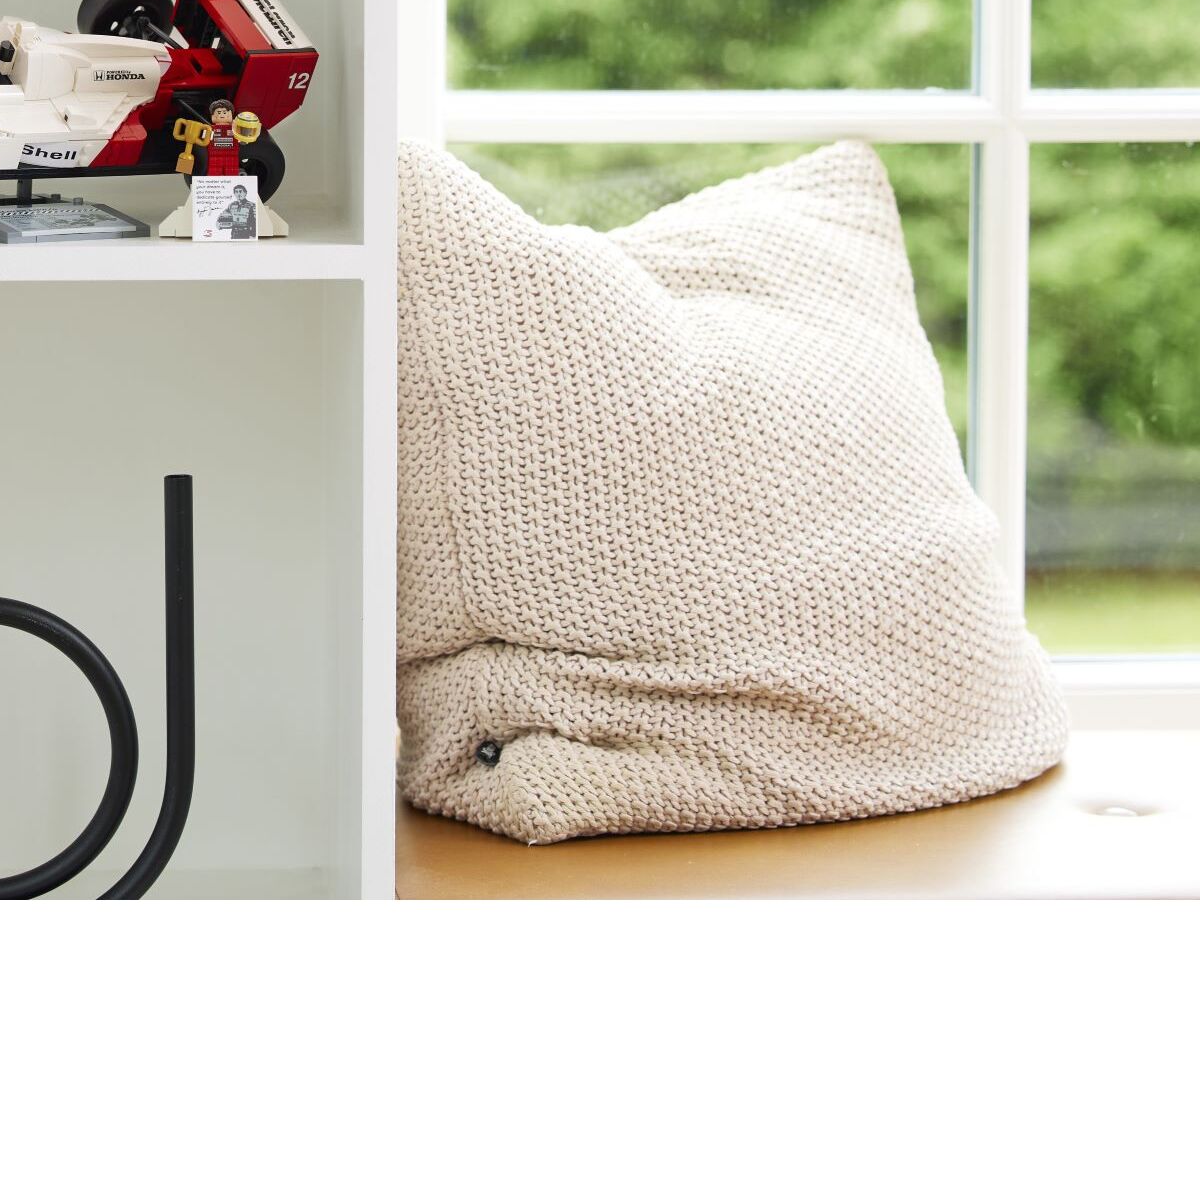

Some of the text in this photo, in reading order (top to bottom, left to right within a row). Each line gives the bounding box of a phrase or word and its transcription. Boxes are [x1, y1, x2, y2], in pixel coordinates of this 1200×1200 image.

[106, 73, 146, 81] HONDA
[288, 72, 311, 90] 12
[21, 143, 78, 161] Shell
